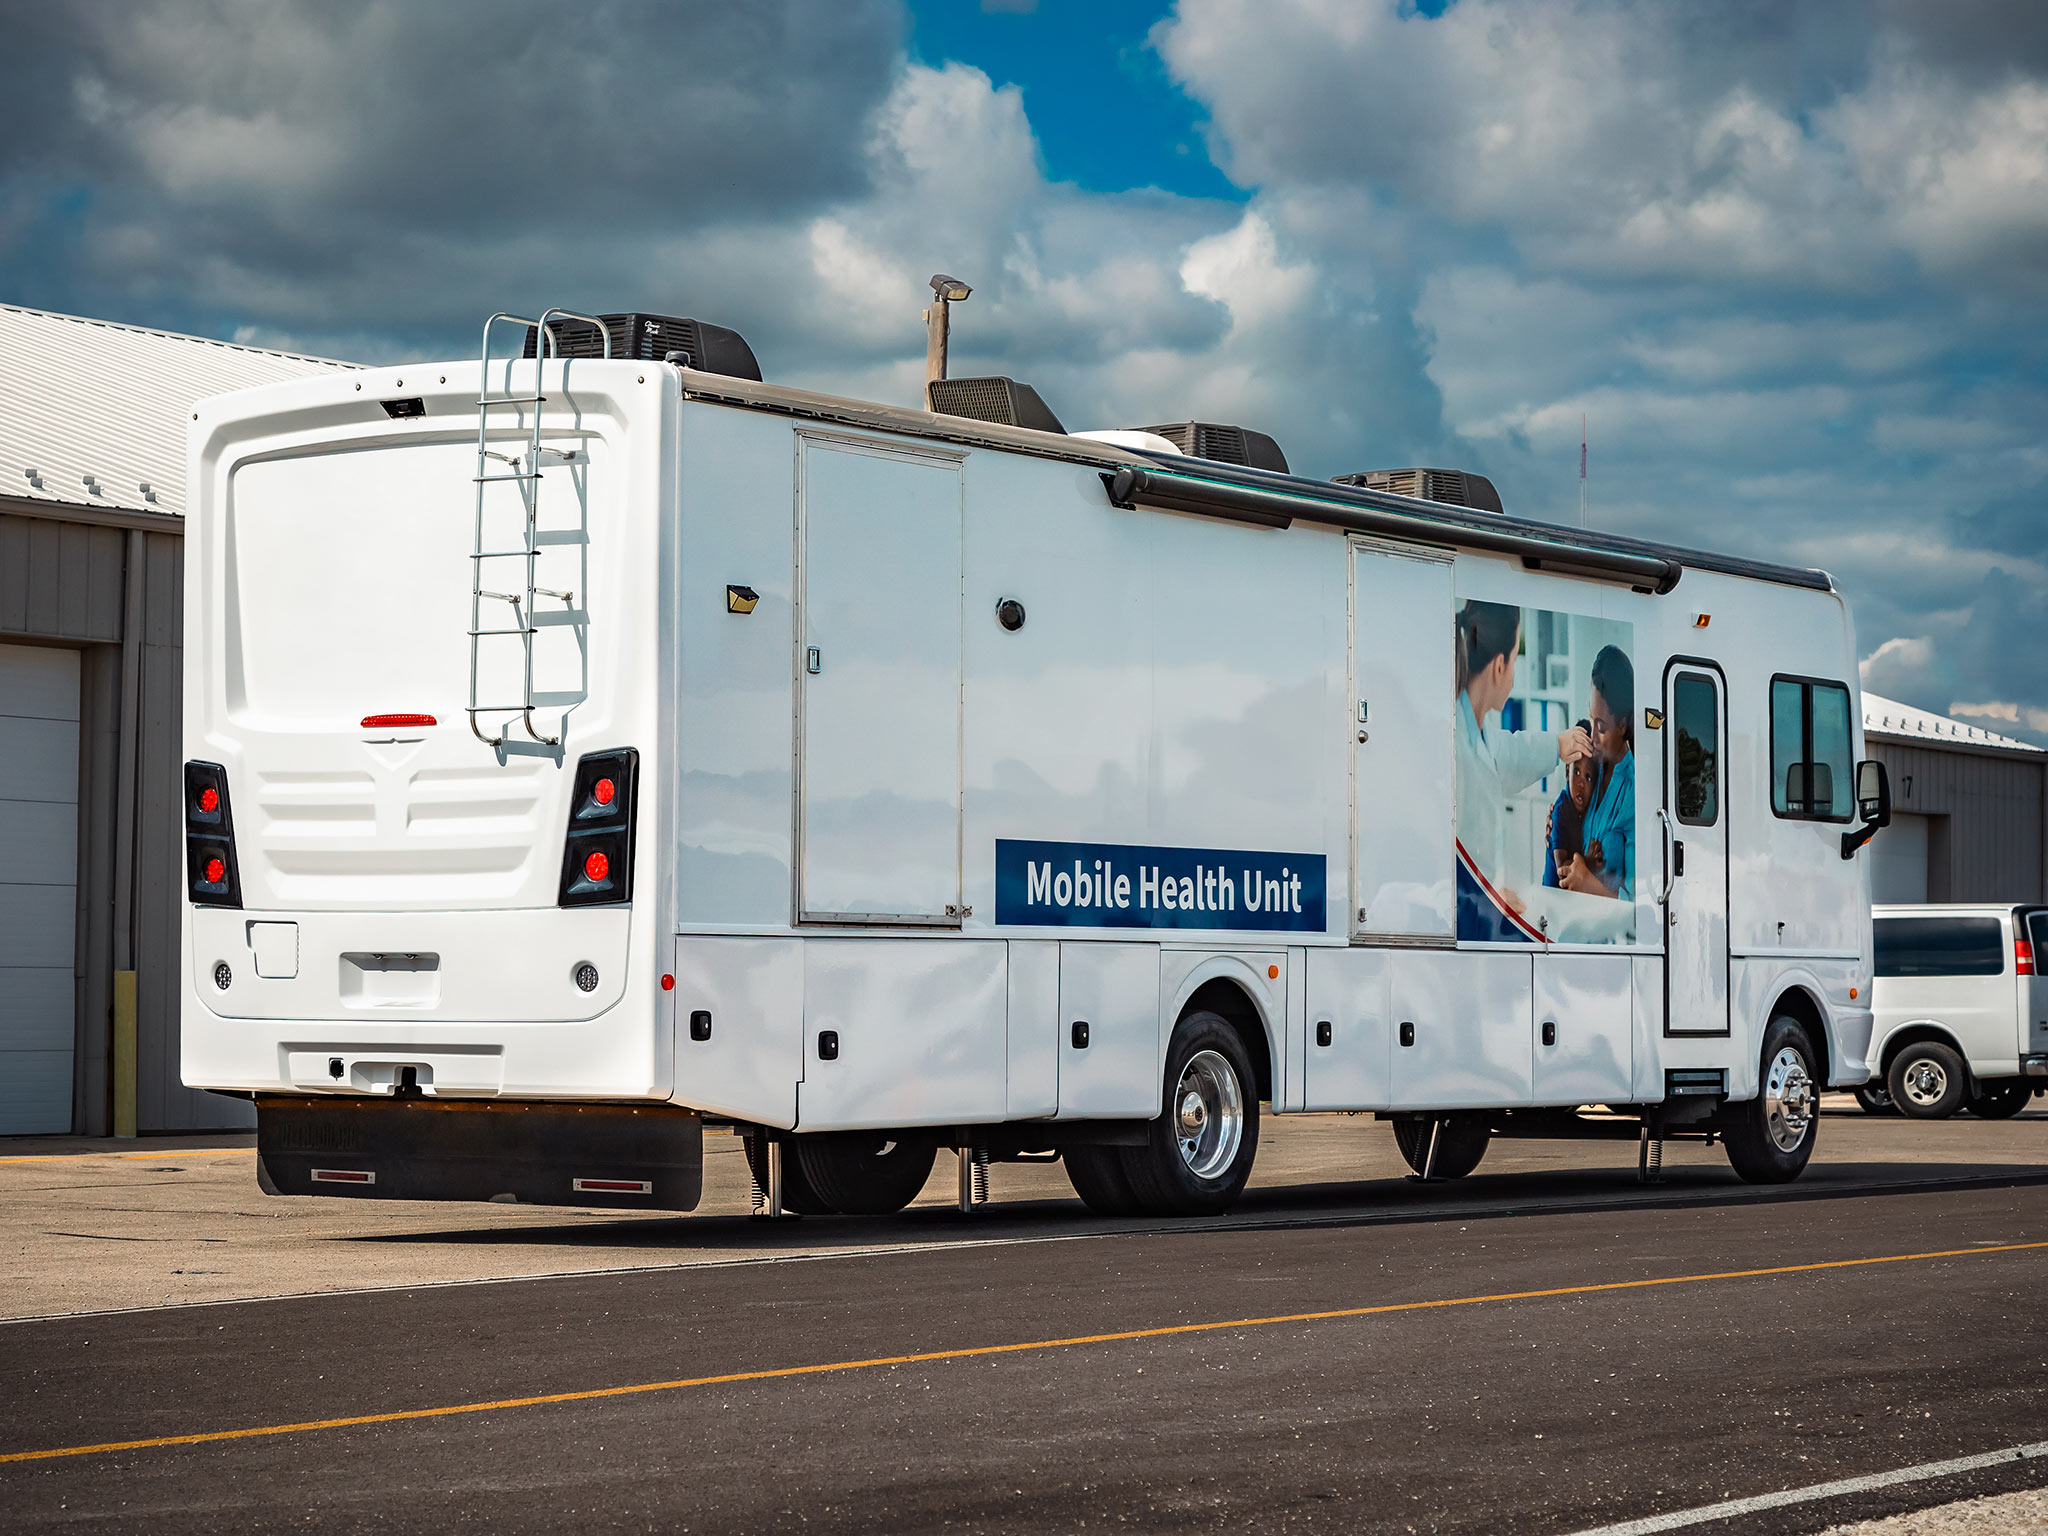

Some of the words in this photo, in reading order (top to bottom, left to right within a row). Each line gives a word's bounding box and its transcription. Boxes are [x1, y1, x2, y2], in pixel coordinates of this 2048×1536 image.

[1027, 859, 1131, 909] Mobile
[1139, 865, 1235, 911] Health
[1243, 867, 1302, 913] Unit
